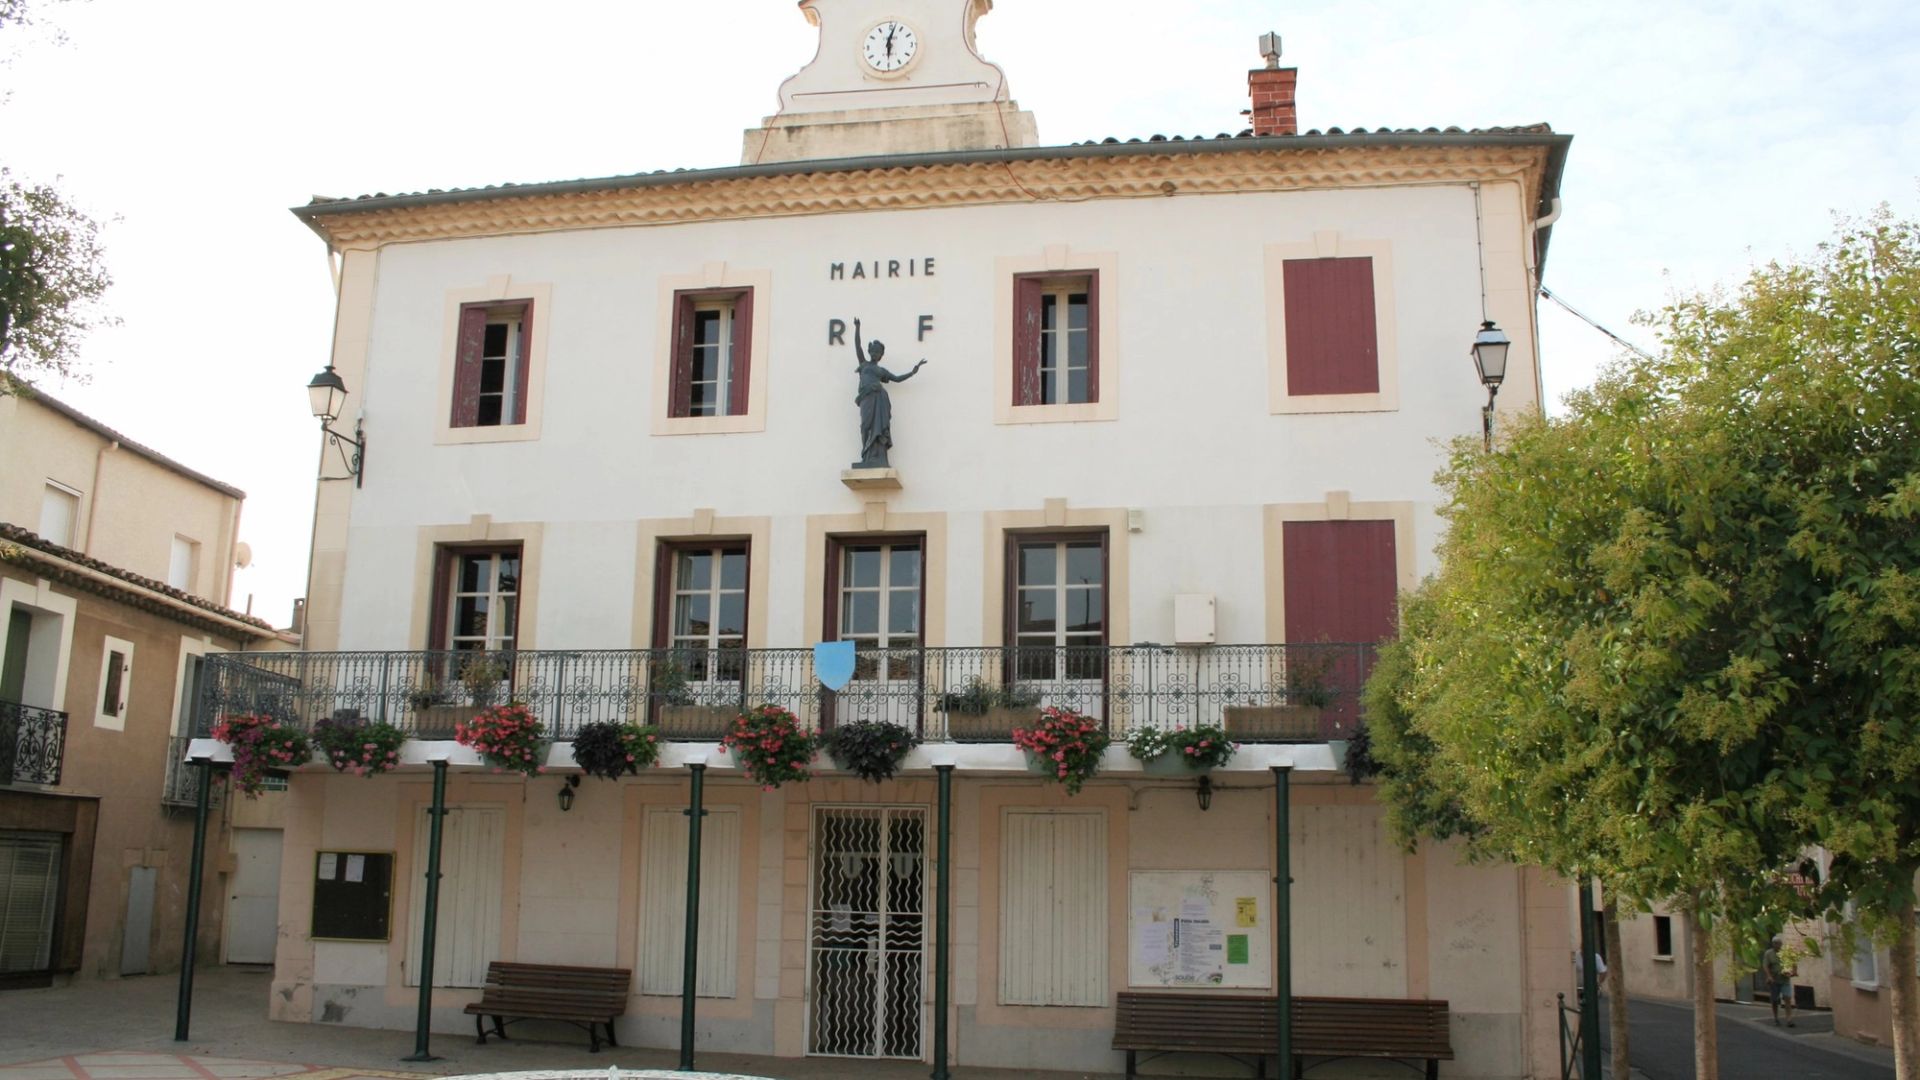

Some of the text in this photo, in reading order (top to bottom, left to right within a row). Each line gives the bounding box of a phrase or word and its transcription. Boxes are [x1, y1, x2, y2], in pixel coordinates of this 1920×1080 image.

[830, 257, 935, 281] MAIRIE
[828, 314, 934, 346] R F
